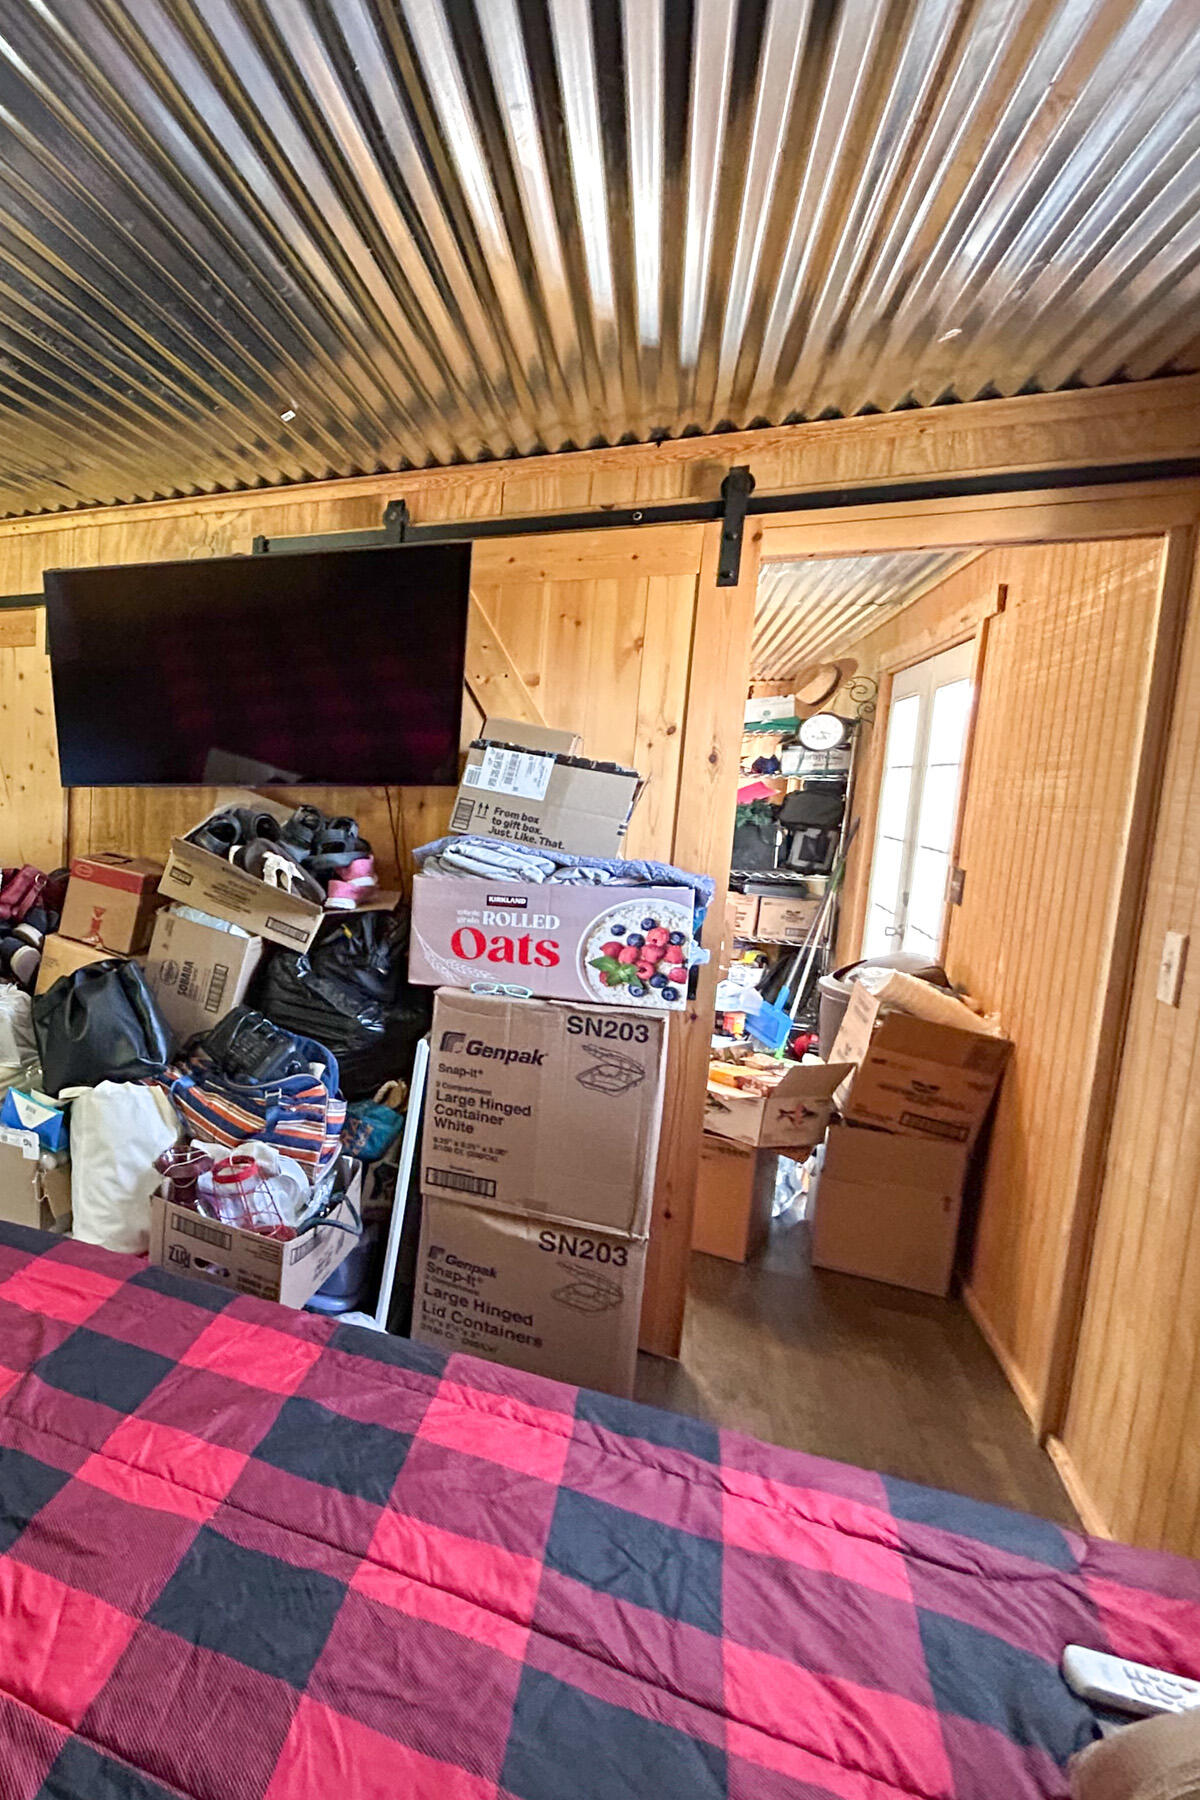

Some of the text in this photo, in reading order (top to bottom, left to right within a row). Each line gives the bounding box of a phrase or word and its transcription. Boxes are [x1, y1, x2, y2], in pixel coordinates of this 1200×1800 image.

[492, 817, 543, 836] to gift box.
[494, 807, 540, 825] From box
[488, 827, 565, 850] Just. Like. That.
[488, 896, 527, 905] KIRKLAND
[482, 911, 560, 930] ROLLED
[451, 927, 560, 968] Oats
[567, 1015, 649, 1043] SN203
[466, 1040, 545, 1066] Genpak
[434, 1104, 505, 1126] Container
[436, 1090, 532, 1117] Large Hinged
[434, 1116, 475, 1134] White
[538, 1230, 628, 1267] SN203
[445, 1254, 498, 1279] Genpak
[424, 1282, 469, 1307] Large
[474, 1299, 533, 1327] Hinged
[422, 1300, 447, 1319] Lid
[451, 1311, 543, 1348] Containers
